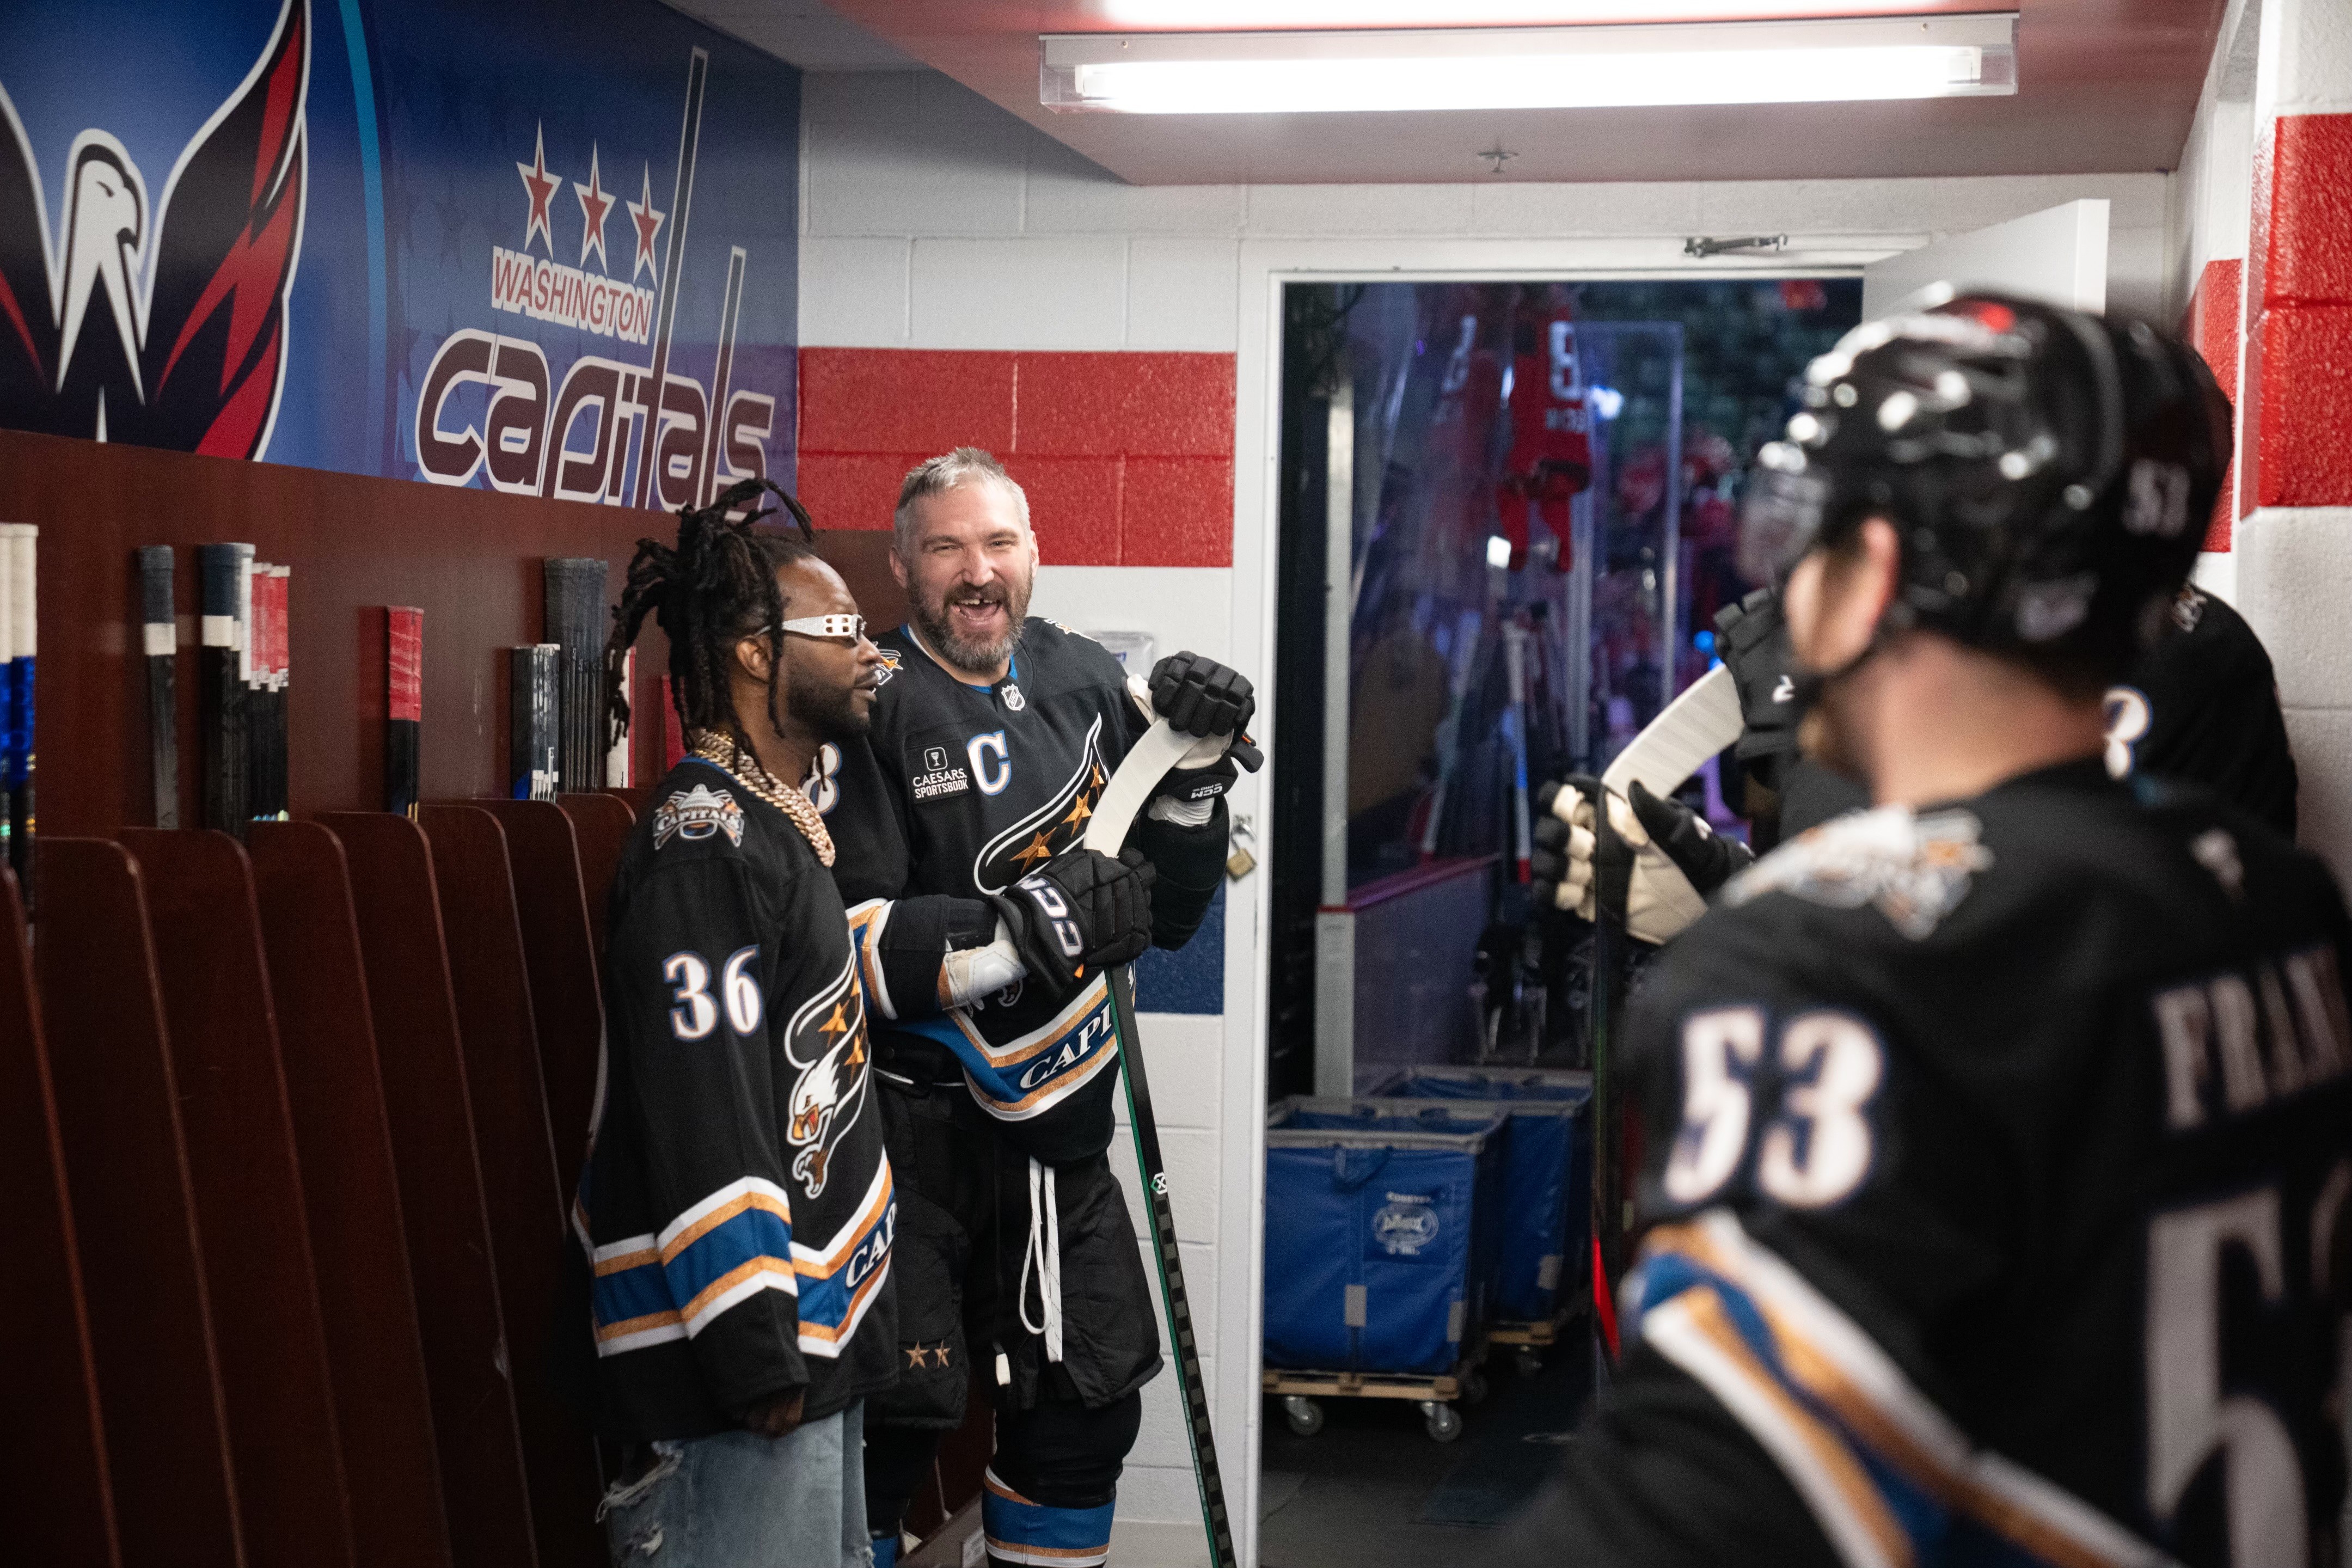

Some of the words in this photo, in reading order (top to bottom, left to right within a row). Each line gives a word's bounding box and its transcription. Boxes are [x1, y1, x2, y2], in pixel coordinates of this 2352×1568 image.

[493, 248, 653, 344] WASHINGTON
[799, 742, 843, 817] 8
[913, 768, 967, 787] CAESARS
[915, 779, 969, 799] SPORTSBOOK
[966, 730, 1012, 796] C
[1191, 785, 1223, 799] CCM
[662, 945, 765, 1043] 36
[1020, 1002, 1112, 1089] CAPI
[1664, 1006, 1885, 1208] 53
